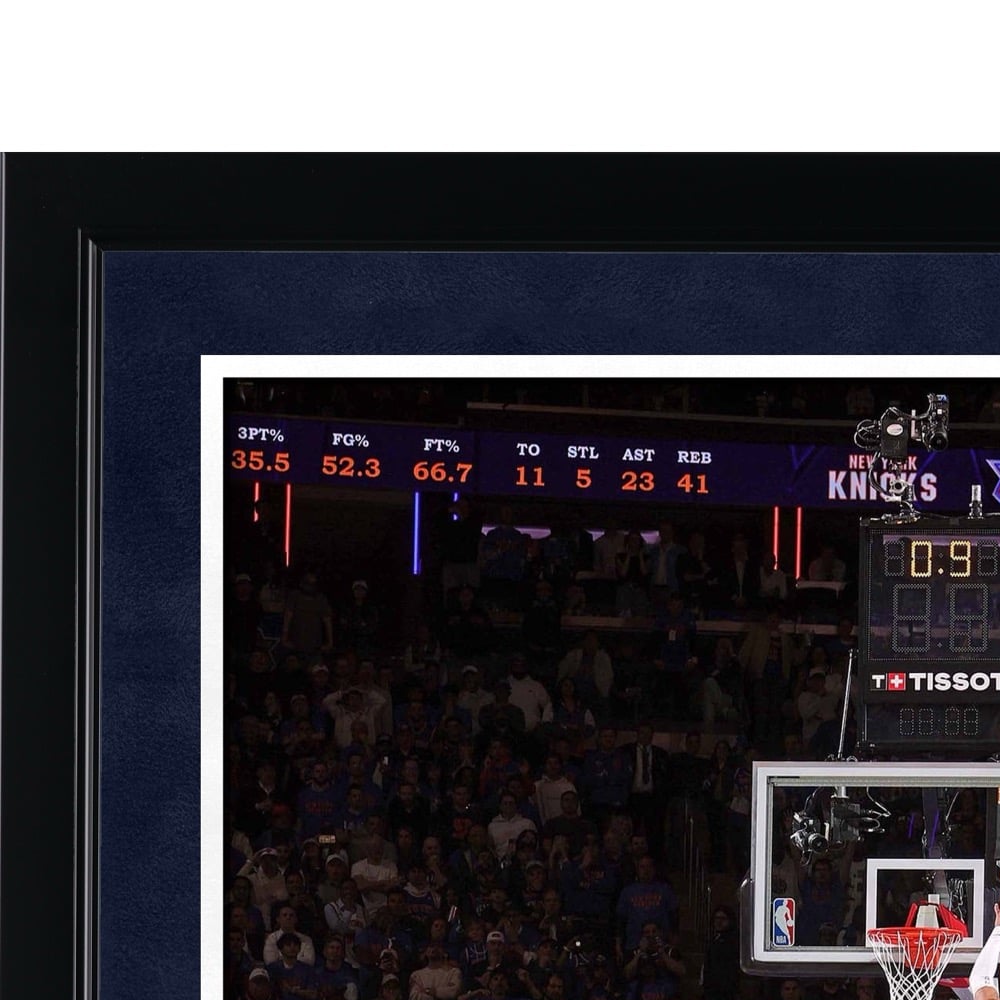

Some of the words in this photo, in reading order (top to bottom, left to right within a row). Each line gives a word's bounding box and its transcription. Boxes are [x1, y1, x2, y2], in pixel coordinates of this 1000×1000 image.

[237, 426, 285, 442] 3PT%
[331, 432, 370, 448] FG%
[423, 438, 460, 453] FT%
[516, 443, 541, 456] TO
[567, 445, 599, 460] STL
[622, 448, 656, 462] AST
[677, 450, 712, 464] REB
[231, 450, 290, 472] 35.5
[321, 455, 381, 478] 52.3
[413, 461, 473, 483] 66.7
[516, 465, 545, 487] 11
[575, 468, 592, 488] 5
[621, 471, 655, 491] 23
[677, 473, 709, 493] 41
[910, 540, 971, 578] 0.9
